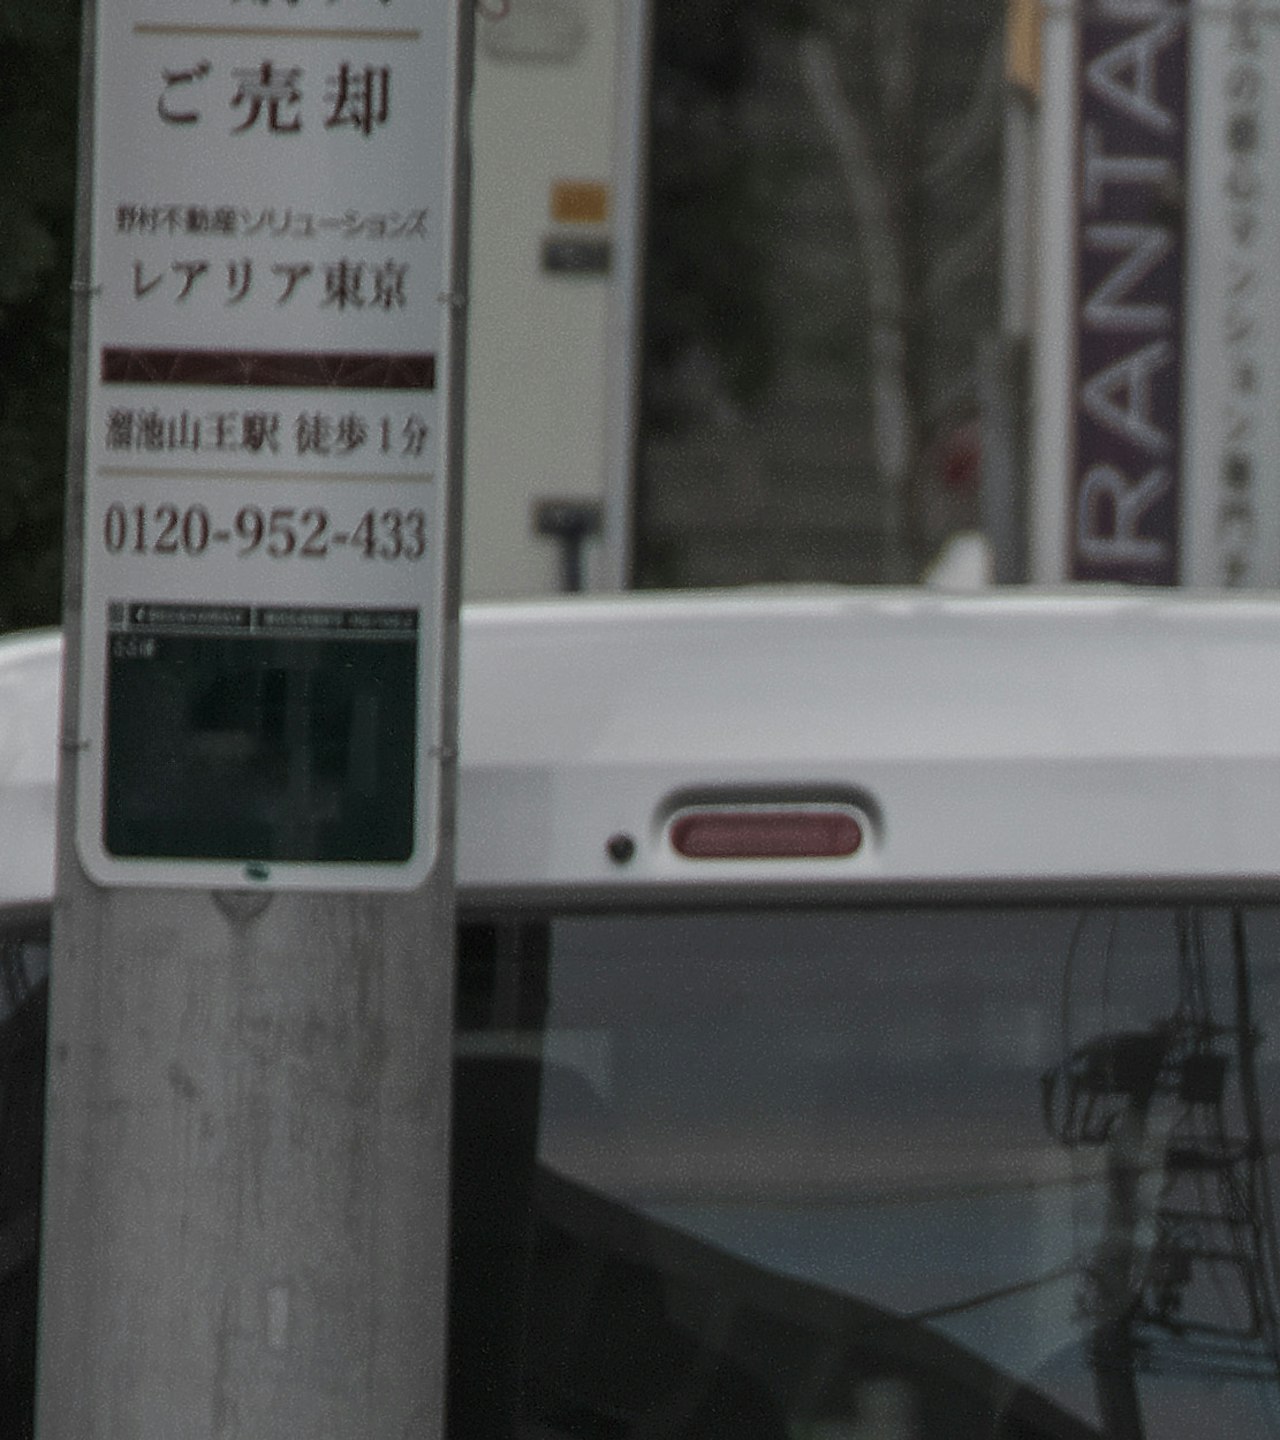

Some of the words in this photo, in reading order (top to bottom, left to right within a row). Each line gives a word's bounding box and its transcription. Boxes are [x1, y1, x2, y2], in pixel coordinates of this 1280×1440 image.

[157, 59, 391, 137] ご売却
[132, 257, 411, 311] レアリア東京
[1079, 0, 1178, 561] RANTA
[103, 501, 428, 560] 0120-952-433
